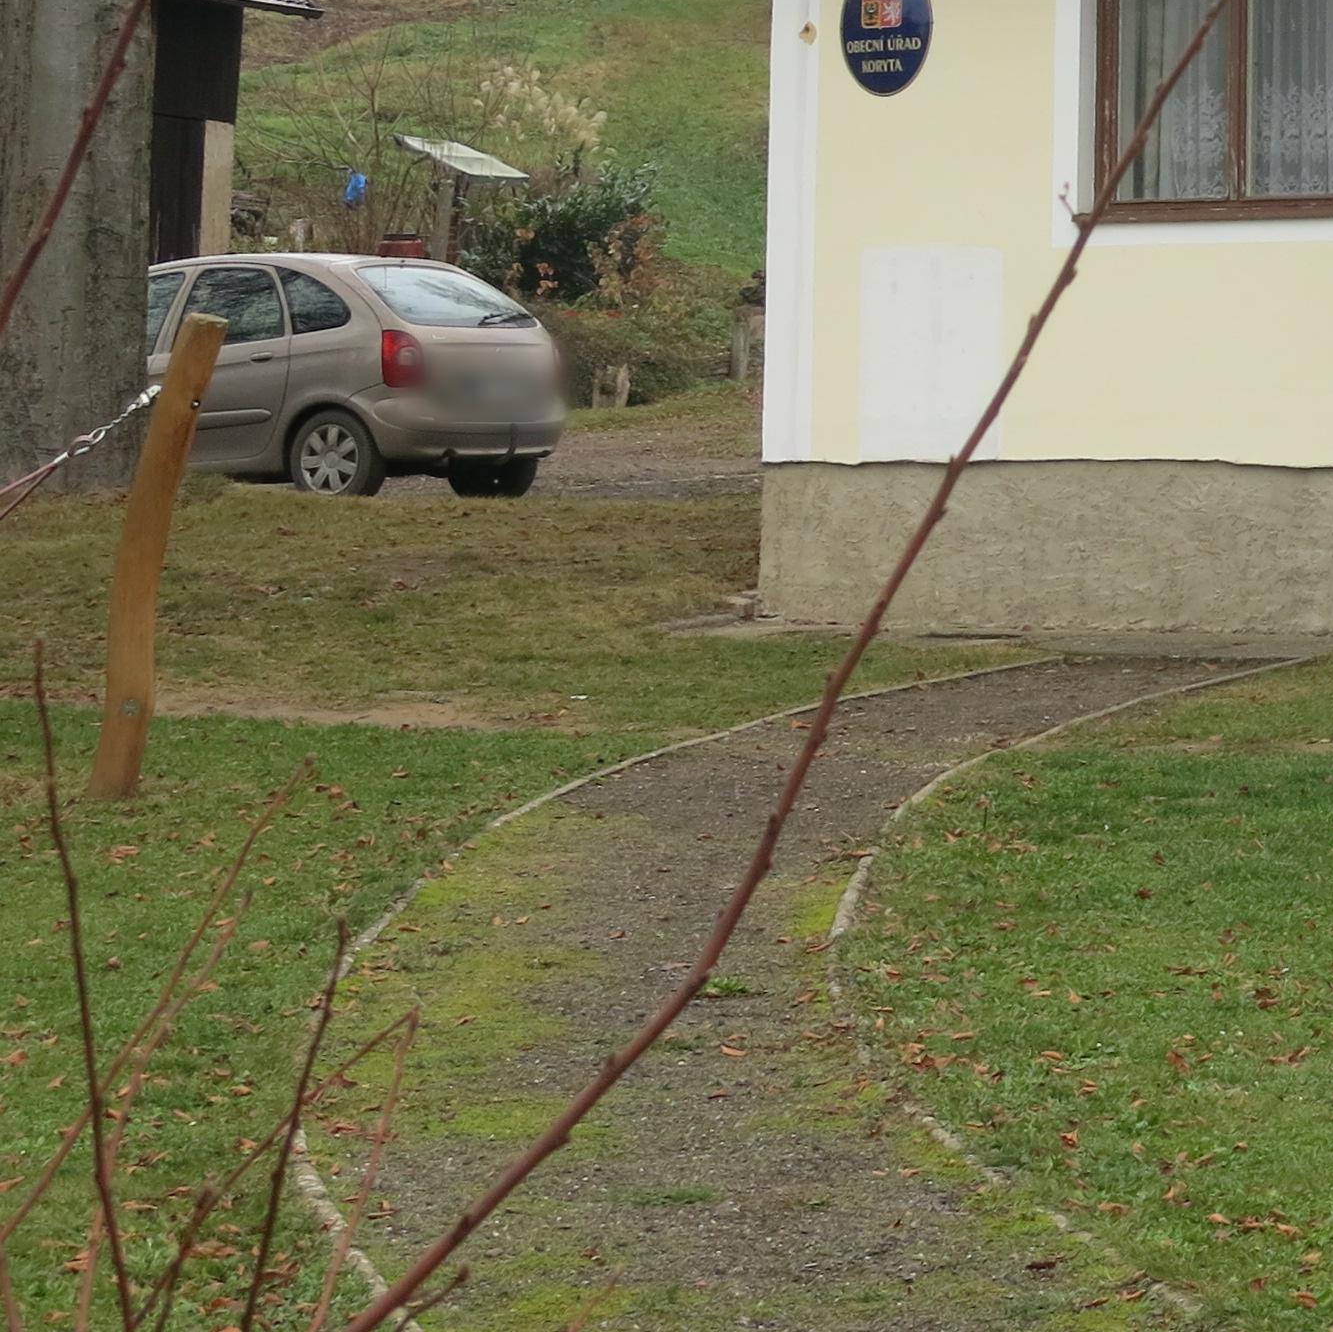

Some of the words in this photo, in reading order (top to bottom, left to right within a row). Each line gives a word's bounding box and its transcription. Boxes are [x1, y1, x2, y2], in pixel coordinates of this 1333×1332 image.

[846, 36, 884, 54] OBECNÍ
[887, 34, 921, 51] ÚŘAD
[862, 59, 903, 74] KORYTA
